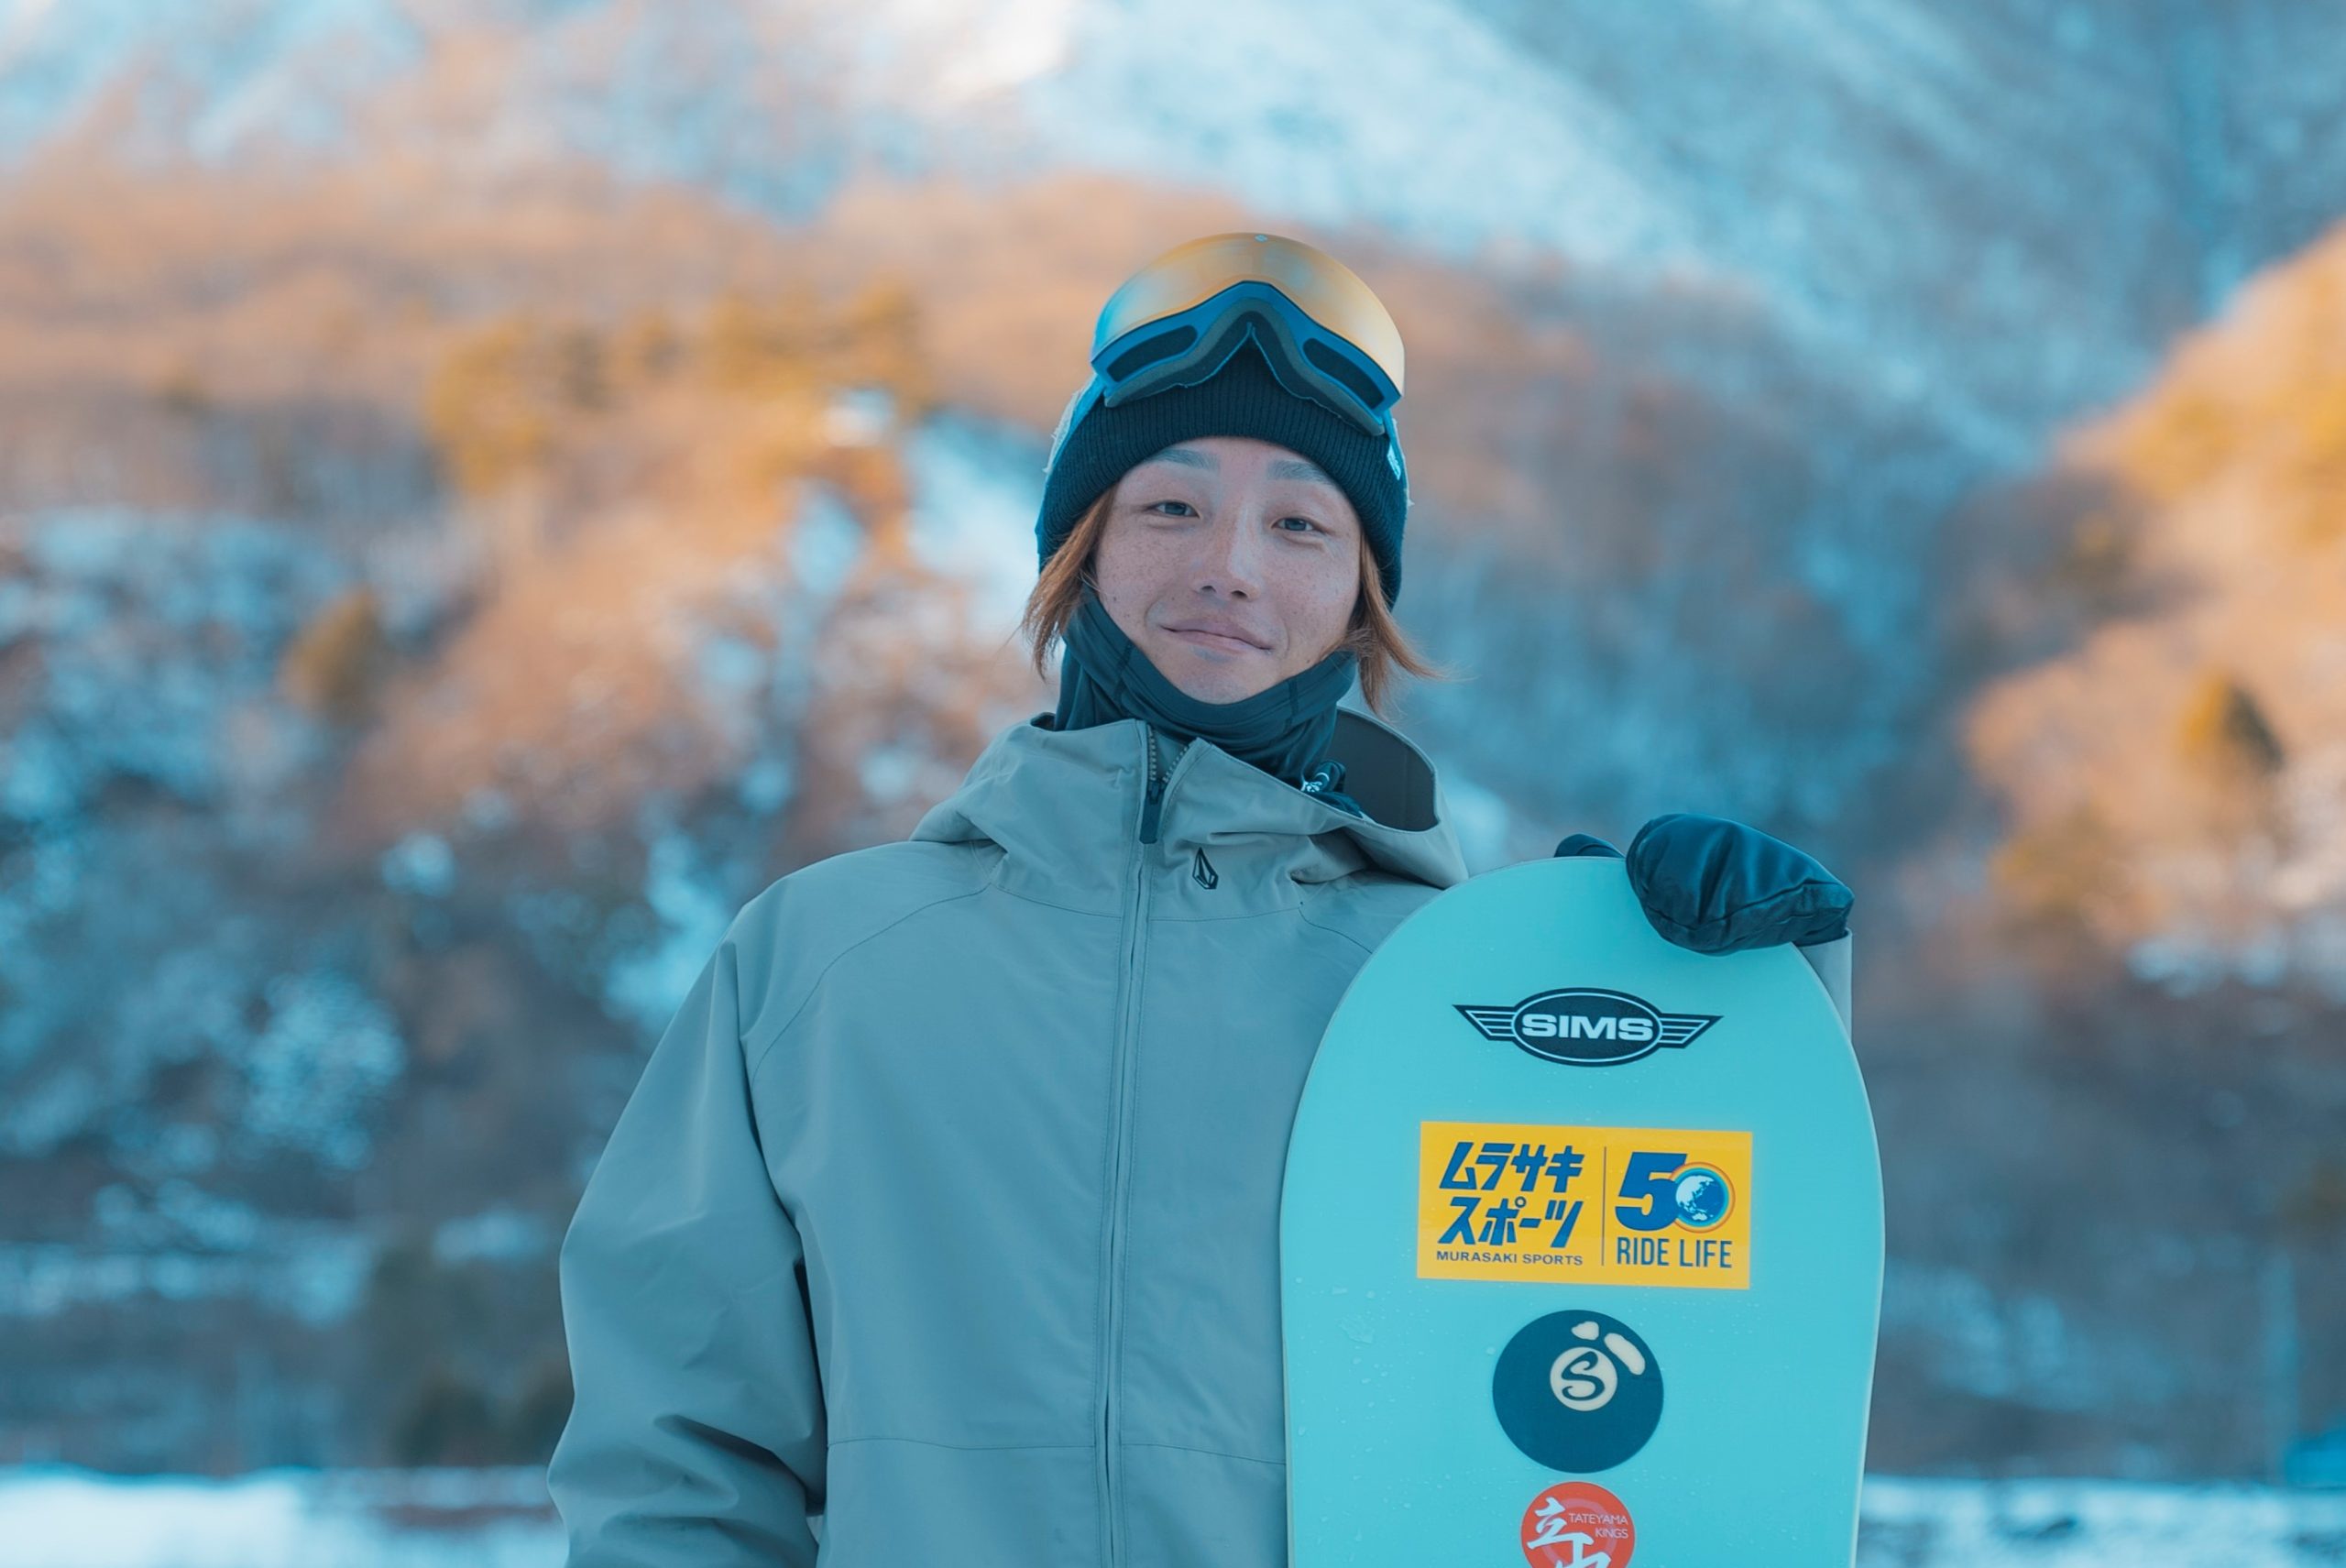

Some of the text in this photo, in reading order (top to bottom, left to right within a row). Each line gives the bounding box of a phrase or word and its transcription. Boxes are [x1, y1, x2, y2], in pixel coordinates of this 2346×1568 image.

[1521, 1013, 1654, 1042] SIMS
[1439, 1141, 1585, 1193] ムラサキ
[1437, 1196, 1584, 1248] スポーツ
[1436, 1250, 1584, 1266] MURASAKI SPORTS
[1617, 1236, 1733, 1268] RIDE LIFE
[1568, 1512, 1628, 1526] TATEYAMA
[1595, 1527, 1629, 1540] KINGS
